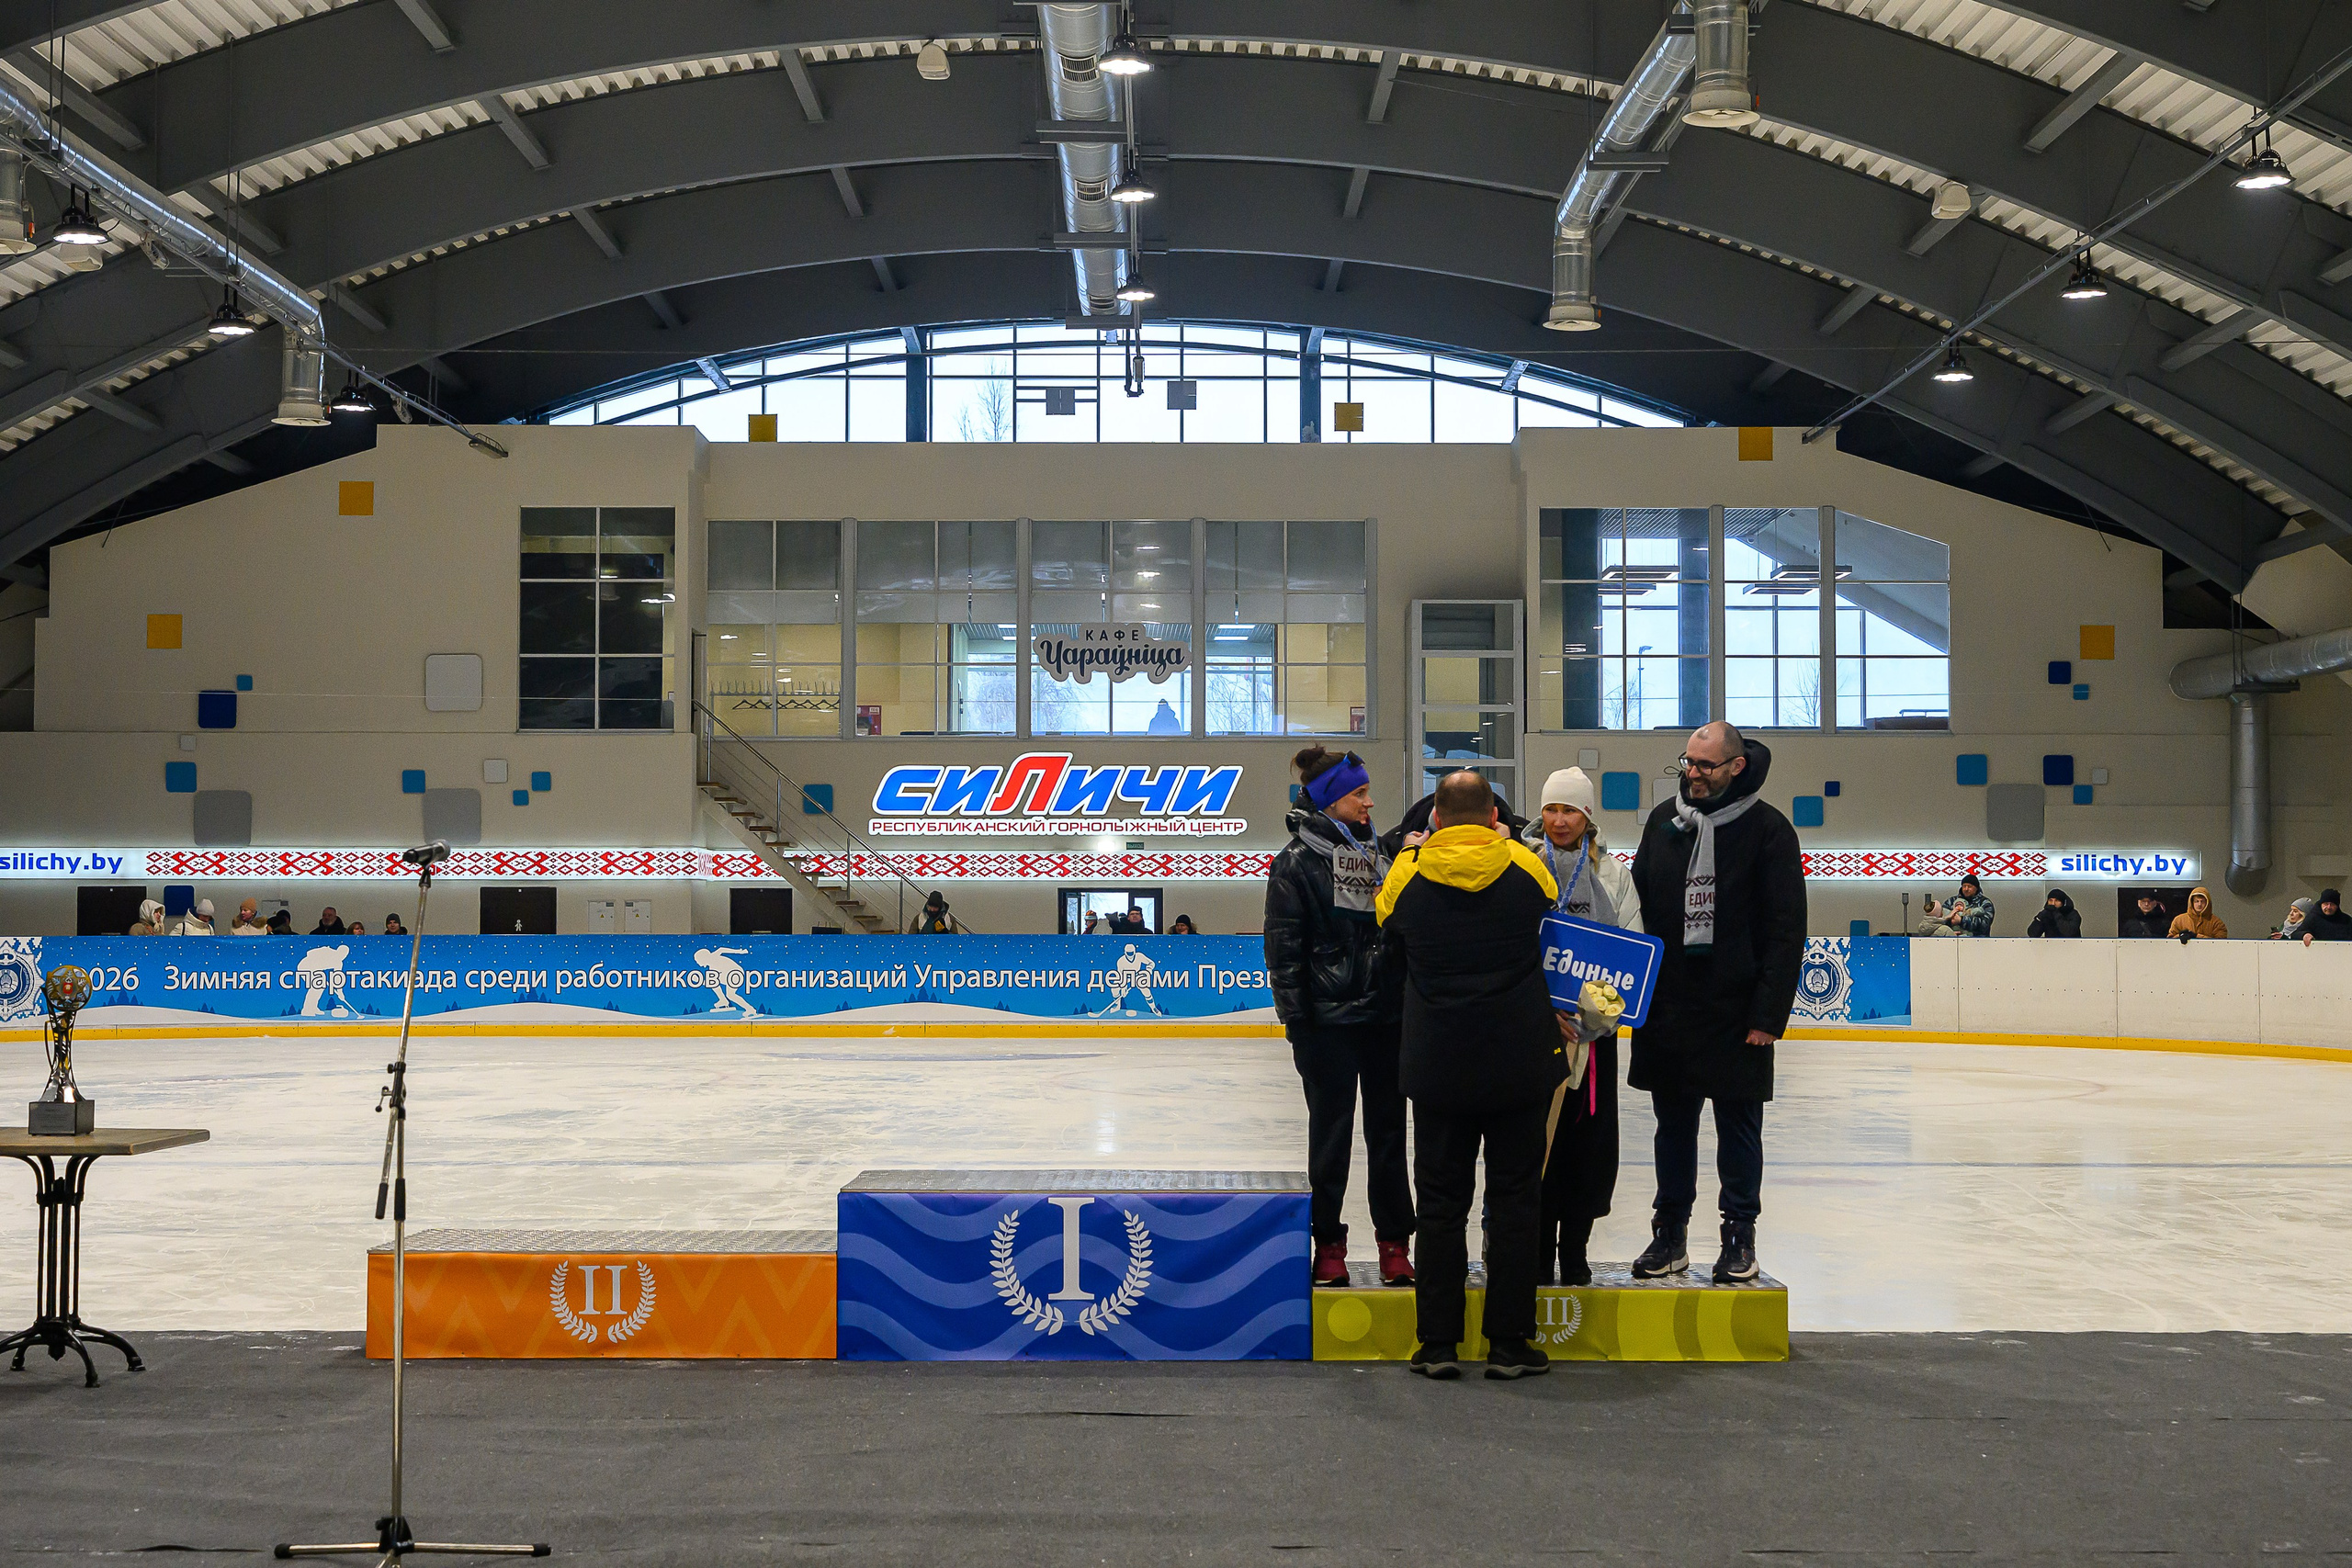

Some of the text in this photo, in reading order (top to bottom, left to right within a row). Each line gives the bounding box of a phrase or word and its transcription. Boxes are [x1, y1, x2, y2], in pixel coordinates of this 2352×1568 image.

[1085, 629, 1139, 641] КАФЕ
[1040, 639, 1185, 678] Чараўніца
[872, 819, 1244, 836] РЕСПУБЛИКАНСКИЙ ГОРНОЛЫЖНЫЙ ЦЕНТР
[0, 852, 124, 874] silichy.by
[2061, 853, 2188, 875] silichy.by
[81, 962, 1272, 995] 026 Зимняя спартакиада среди работников организаций Управления делами През
[1543, 945, 1635, 991] Единые
[1047, 1197, 1095, 1301] I
[577, 1265, 628, 1315] II
[1535, 1296, 1572, 1325] II
